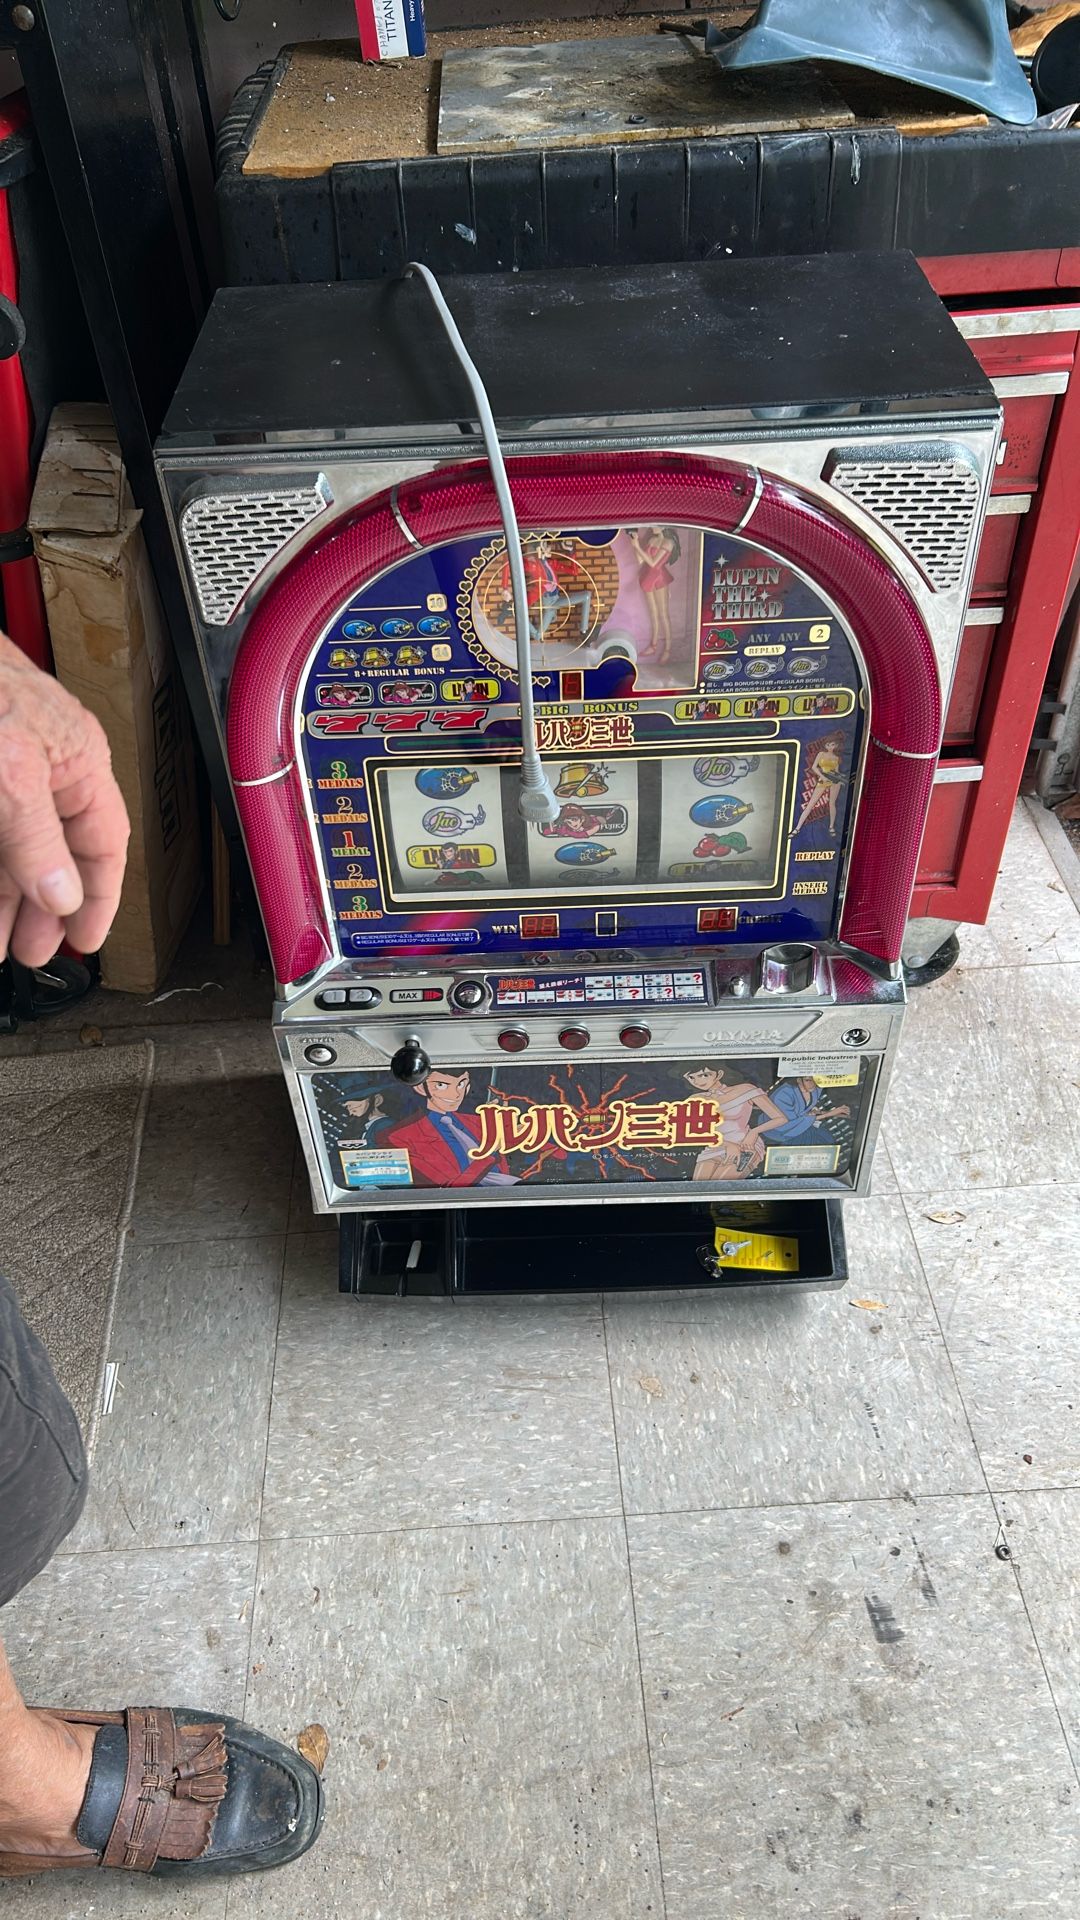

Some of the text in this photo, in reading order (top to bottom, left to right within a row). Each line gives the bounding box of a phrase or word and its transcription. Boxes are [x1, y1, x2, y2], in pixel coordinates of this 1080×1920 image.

[383, 0, 398, 42] TITAN
[713, 568, 782, 587] LUPIN
[712, 585, 758, 603] THE
[712, 601, 783, 620] THIRD
[748, 628, 824, 643] ANY ANY 2
[748, 646, 781, 655] REPLAY
[414, 667, 445, 676] BONUS
[452, 682, 489, 697] LUIN
[583, 702, 639, 715] BONUS
[685, 698, 839, 716] LUIN LUIN LUIN
[314, 708, 489, 735] 7 7 7
[331, 761, 347, 779] 3
[700, 758, 730, 781] Jac
[317, 778, 364, 789] MEDALS
[336, 796, 353, 814] 2
[323, 813, 368, 824] MEDALS
[430, 811, 459, 833] Jac
[343, 831, 355, 848] 1
[332, 847, 371, 857] MEDAL
[423, 848, 480, 865] LUIN
[795, 850, 835, 861] REPLAY
[347, 864, 363, 880] 2
[334, 878, 378, 889] MEDALS
[792, 887, 827, 895] MEDALS
[794, 881, 828, 889] INSERT
[352, 896, 368, 912] 3
[339, 910, 384, 921] MEDALS
[492, 924, 518, 934] WIN
[331, 991, 364, 1001] 1 2
[703, 1028, 783, 1042] OLYMPIA
[468, 1096, 724, 1159] ルパン三世
